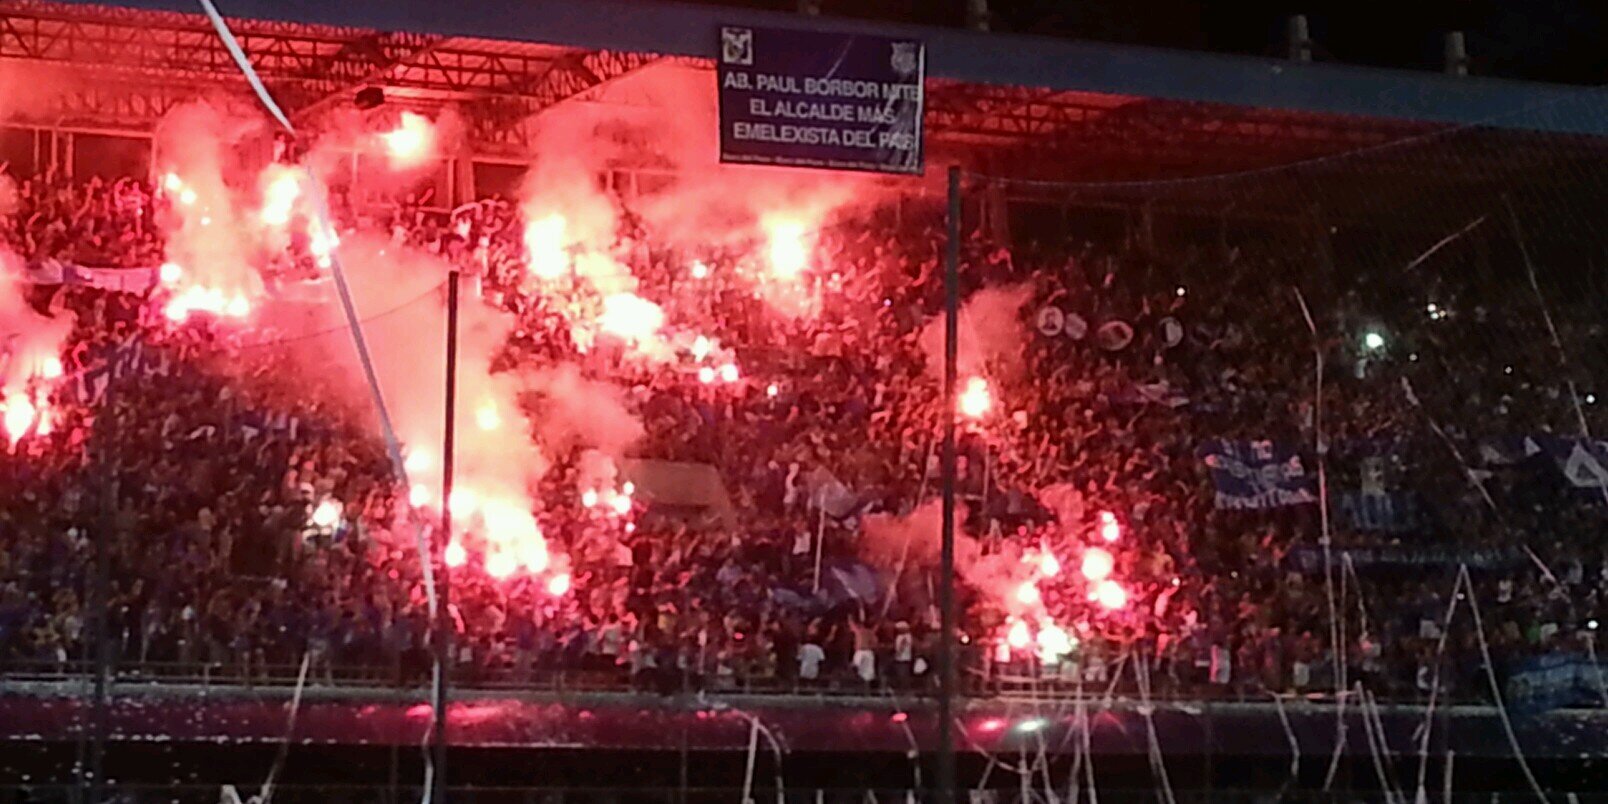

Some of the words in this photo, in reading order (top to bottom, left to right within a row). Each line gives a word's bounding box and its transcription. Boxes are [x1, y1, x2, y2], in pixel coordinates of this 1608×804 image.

[724, 72, 752, 91] AB.
[757, 75, 800, 93] PAUL
[805, 78, 880, 99] BORBOR
[750, 99, 772, 116] EL
[775, 102, 853, 121] ALCALDE
[734, 122, 840, 146] EMELEXISTA
[843, 131, 876, 148] DEL
